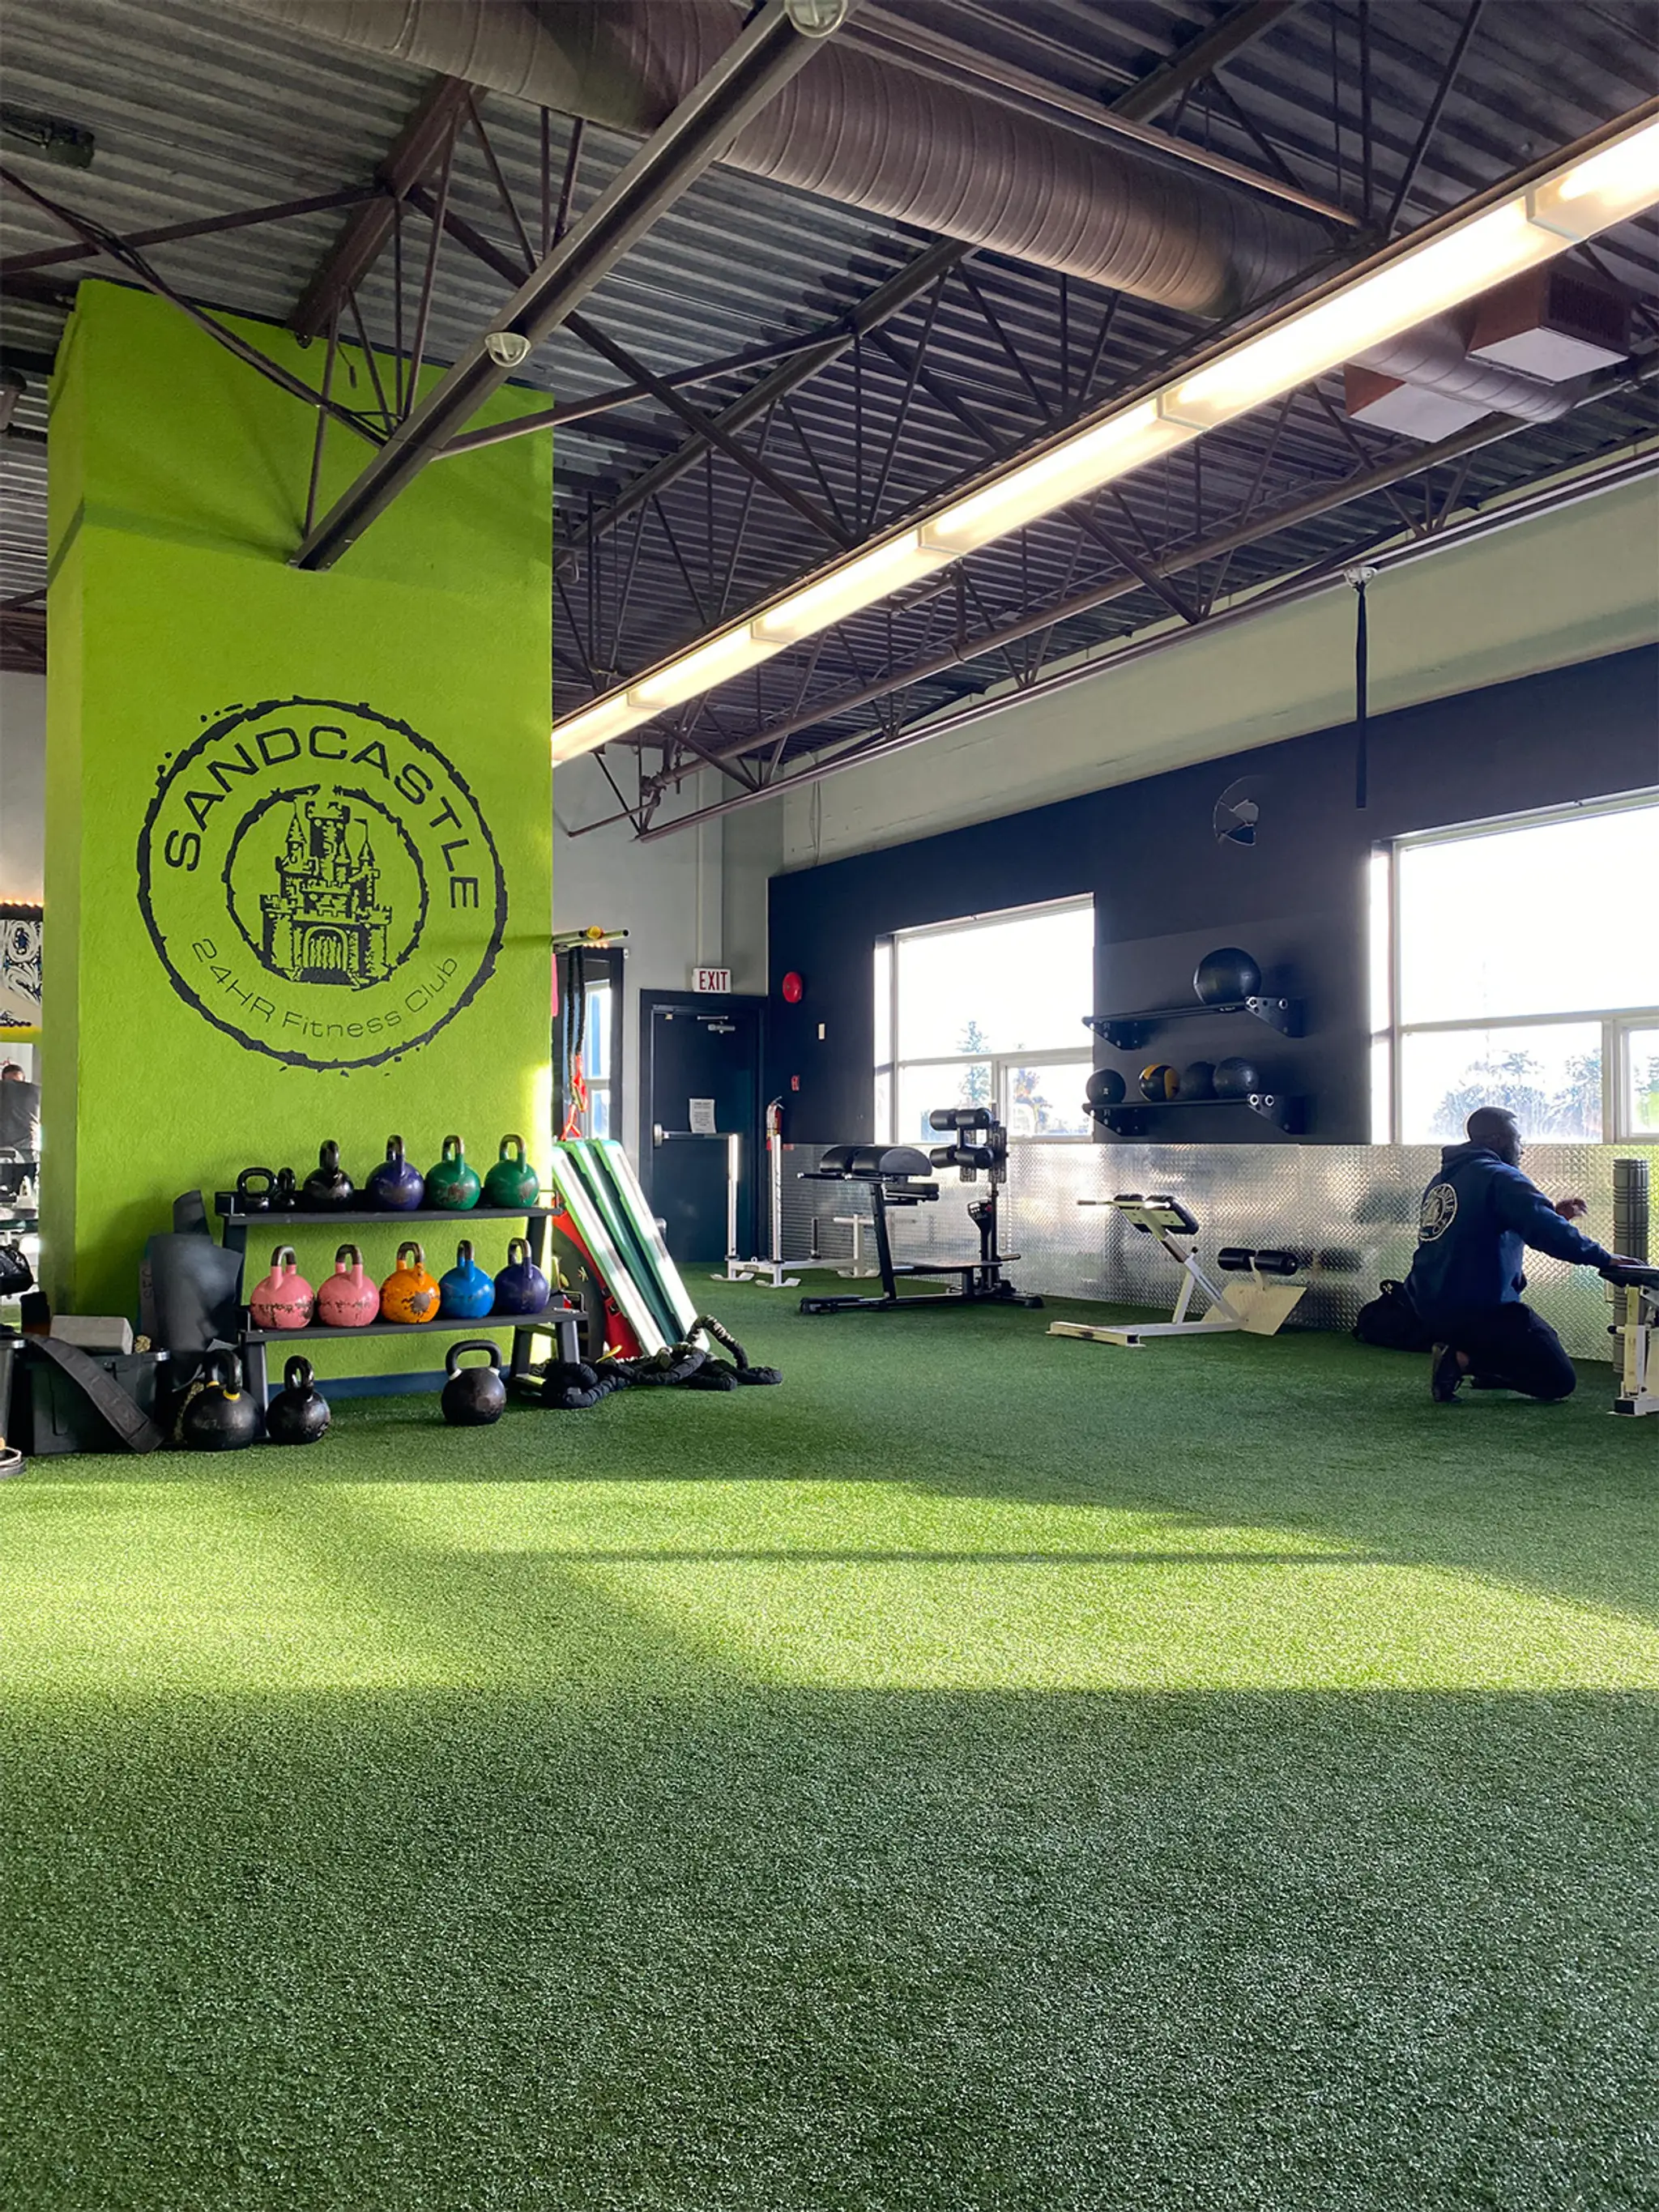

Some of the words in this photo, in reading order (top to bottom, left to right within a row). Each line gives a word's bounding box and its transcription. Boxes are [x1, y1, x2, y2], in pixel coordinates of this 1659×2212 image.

[164, 726, 479, 910] SANDCASTLE
[192, 939, 275, 1022] 24HR
[282, 1011, 402, 1038] Fitness
[405, 957, 458, 1013] Club
[699, 970, 728, 991] EXIT
